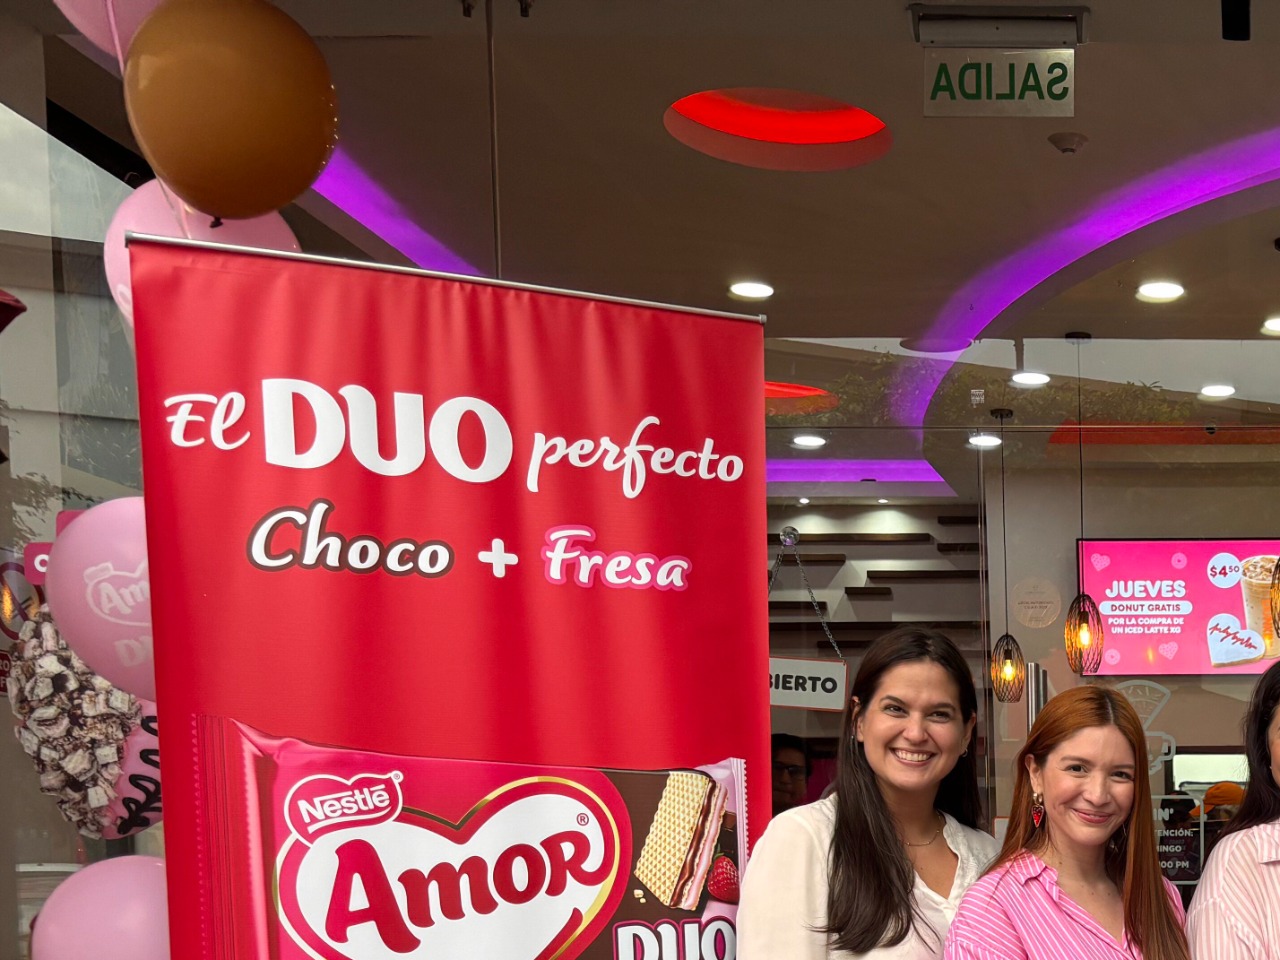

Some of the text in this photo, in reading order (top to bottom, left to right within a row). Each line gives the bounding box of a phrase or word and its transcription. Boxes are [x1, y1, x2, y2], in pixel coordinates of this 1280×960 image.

[163, 377, 744, 499] El DUO perfecto
[247, 499, 453, 577] Choco
[543, 526, 690, 589] Fresa
[98, 577, 150, 616] Am
[1105, 580, 1186, 598] JUEVES
[1110, 604, 1181, 612] DONUT GRATIS
[1108, 617, 1185, 625] POR LA COMPRA DE
[1111, 626, 1123, 634] UN
[1124, 626, 1143, 634] ICED
[1145, 626, 1169, 634] LATTE
[297, 783, 391, 824] Nestlé
[1175, 861, 1190, 869] PM
